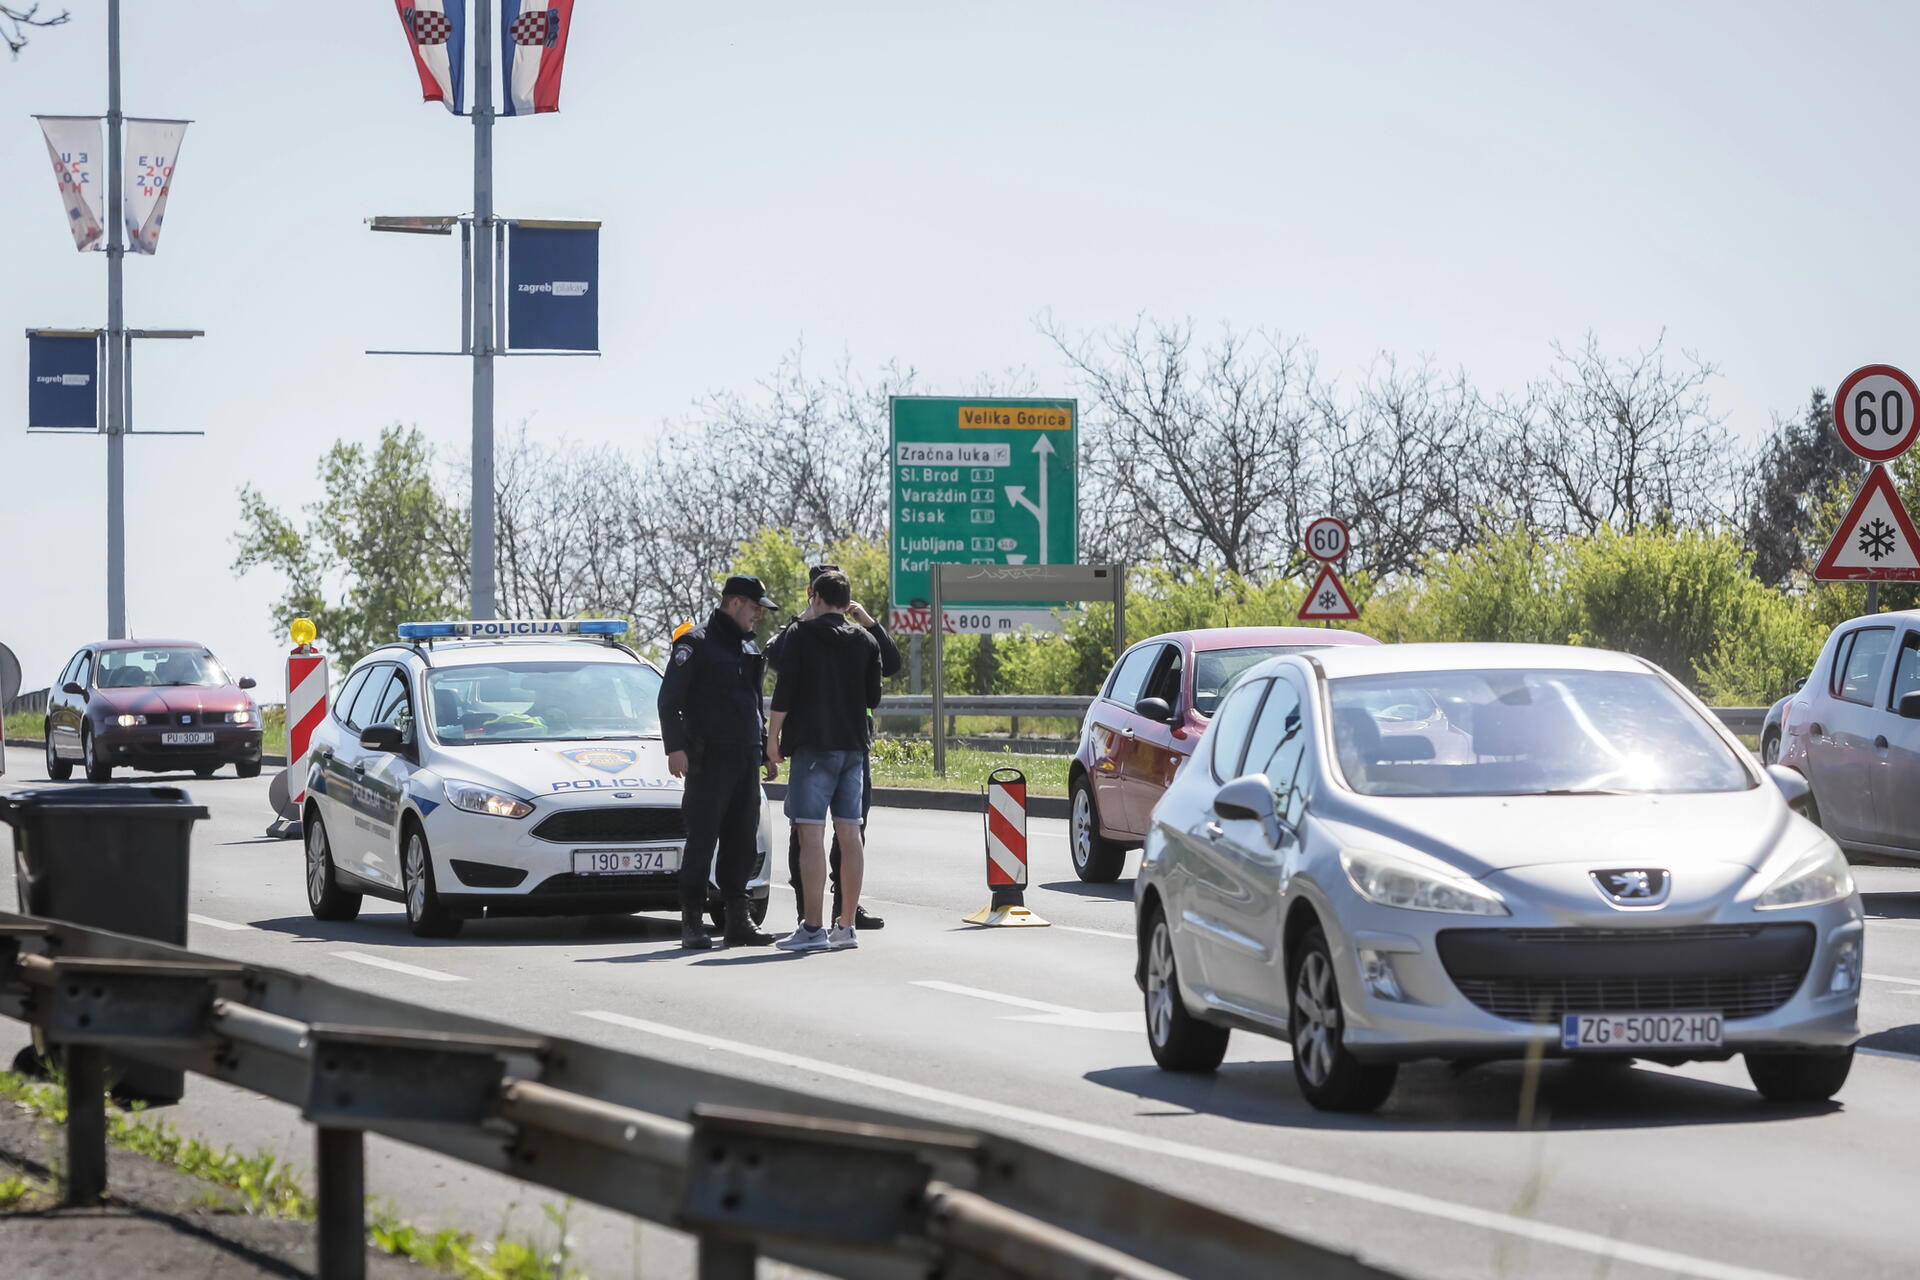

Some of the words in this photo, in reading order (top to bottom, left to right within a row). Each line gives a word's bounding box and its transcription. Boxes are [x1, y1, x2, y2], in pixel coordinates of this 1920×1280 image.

[518, 282, 552, 294] zagreb
[964, 411, 1011, 426] Velika
[1017, 411, 1066, 426] Gorica
[1855, 390, 1903, 436] 60
[900, 446, 953, 461] Zračna
[959, 447, 990, 462] luka
[901, 468, 920, 482] Sl.
[923, 468, 959, 482] Brod
[901, 488, 967, 503] Varaždin
[901, 508, 945, 523] Sisak
[900, 537, 964, 554] Ljubljana
[1314, 529, 1339, 550] 60
[471, 622, 563, 634] POLICIJA
[959, 615, 991, 628] 800
[999, 616, 1011, 628] m
[552, 778, 680, 791] POLICIJA
[592, 854, 618, 870] 190
[634, 853, 664, 869] 374
[1581, 1018, 1610, 1043] ZG
